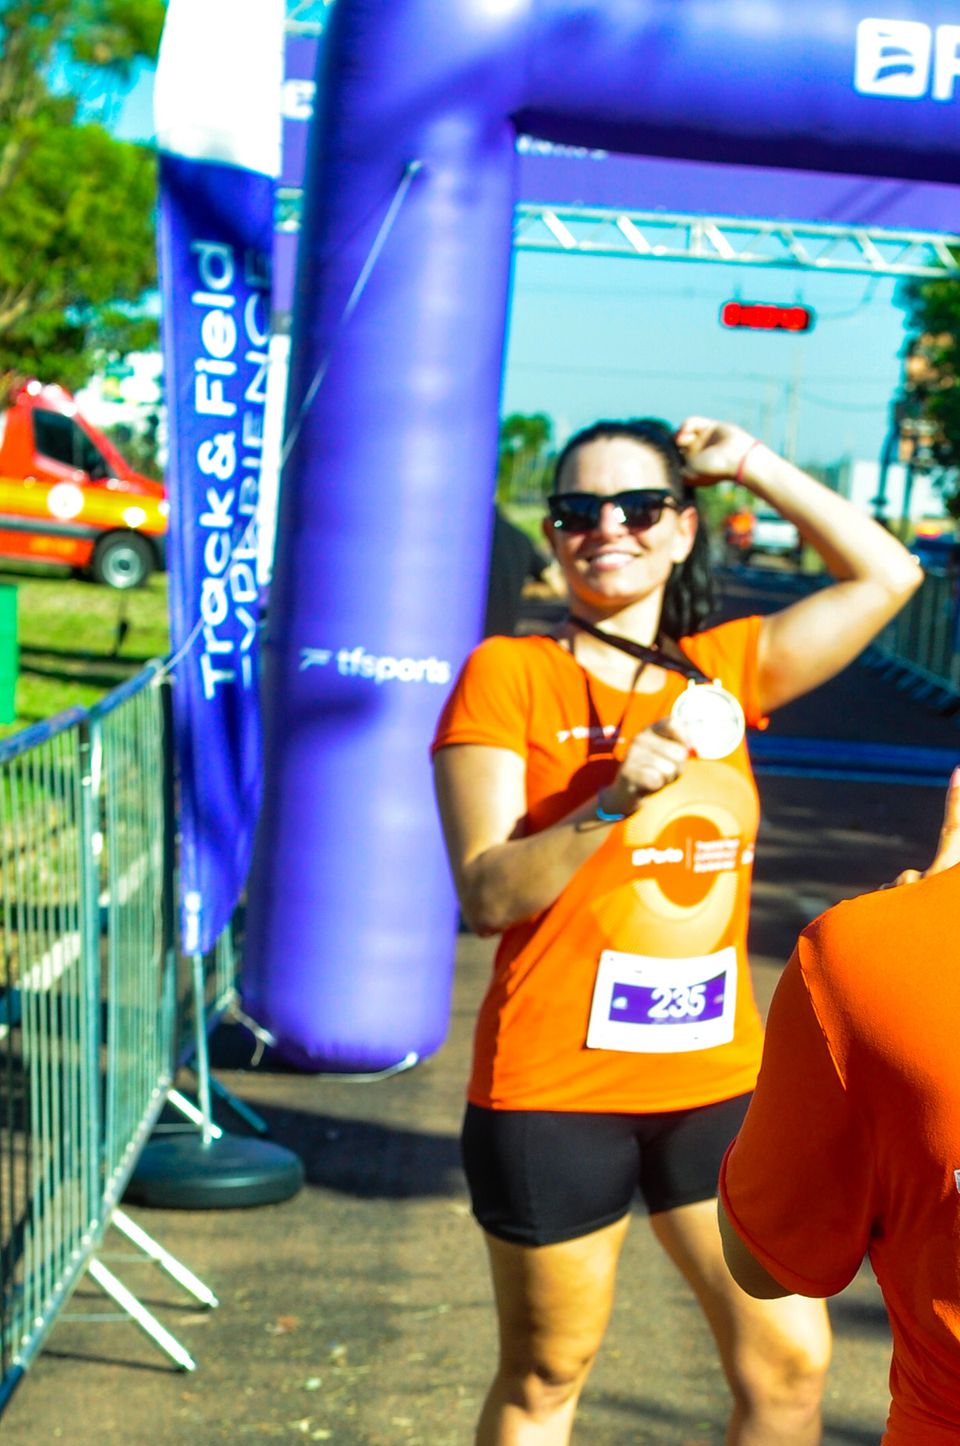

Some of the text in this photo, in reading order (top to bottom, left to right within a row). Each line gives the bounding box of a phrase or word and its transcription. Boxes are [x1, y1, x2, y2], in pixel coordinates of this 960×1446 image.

[190, 240, 237, 416] Field
[199, 487, 235, 700] Track
[336, 646, 450, 685] tfsports
[647, 984, 706, 1019] 235
